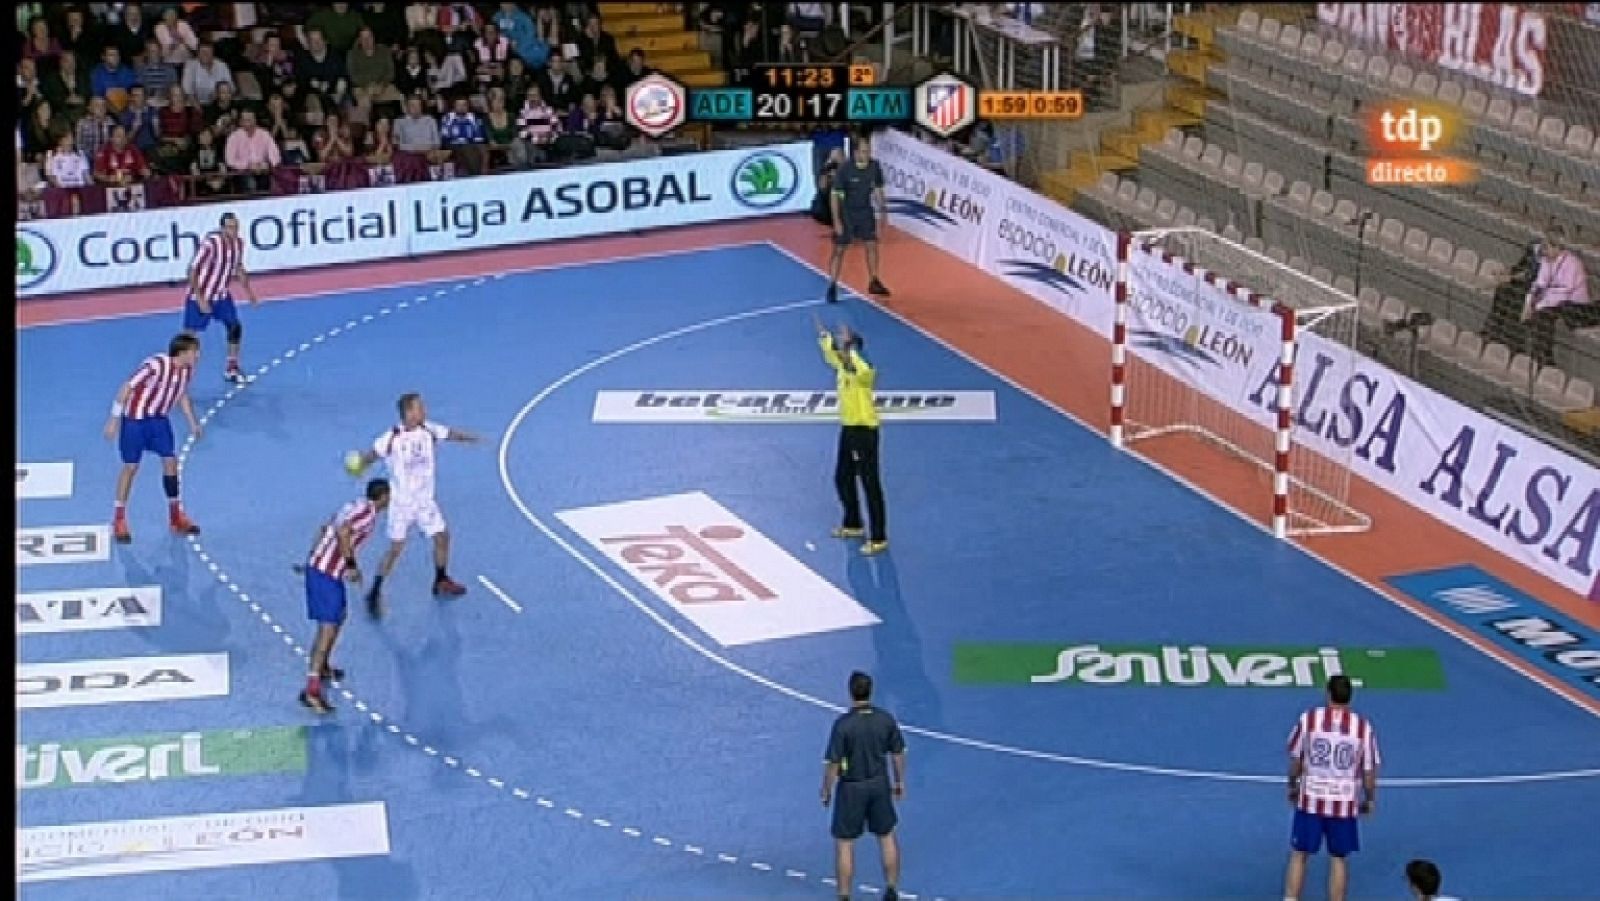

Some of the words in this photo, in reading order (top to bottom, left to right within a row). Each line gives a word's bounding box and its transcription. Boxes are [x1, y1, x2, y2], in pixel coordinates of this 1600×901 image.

[78, 221, 212, 267] Coch
[250, 200, 397, 250] Oficial
[415, 195, 507, 239] Liga
[521, 170, 711, 223] ASOBAL
[938, 187, 985, 226] LEÓN
[1068, 252, 1112, 293] LEÓN
[1200, 324, 1253, 370] LEÓN
[1250, 344, 1407, 474] ALSA
[1419, 424, 1600, 576] ALSA
[1310, 737, 1354, 770] 20
